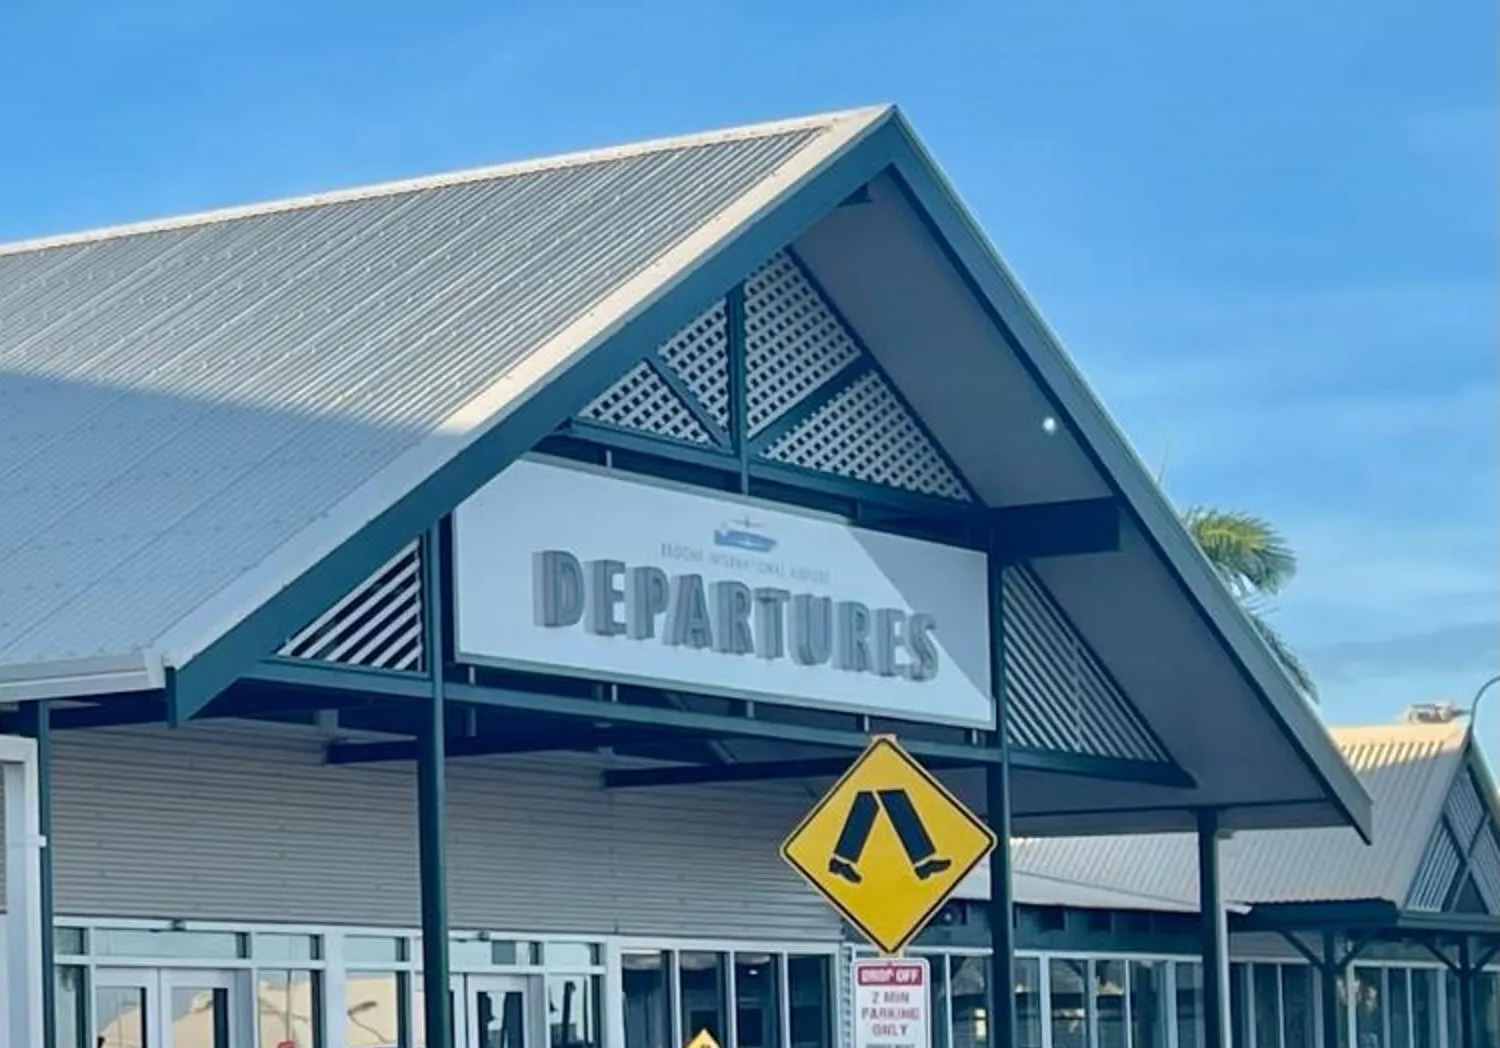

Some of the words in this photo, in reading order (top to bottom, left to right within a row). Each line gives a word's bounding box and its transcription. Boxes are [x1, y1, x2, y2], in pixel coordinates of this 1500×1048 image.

[532, 549, 940, 682] DEPARTURES
[896, 969, 918, 982] OFF
[871, 991, 880, 1004] 2
[884, 991, 910, 1004] MIN
[861, 1008, 920, 1020] PARKING
[873, 1023, 909, 1037] ONLY
